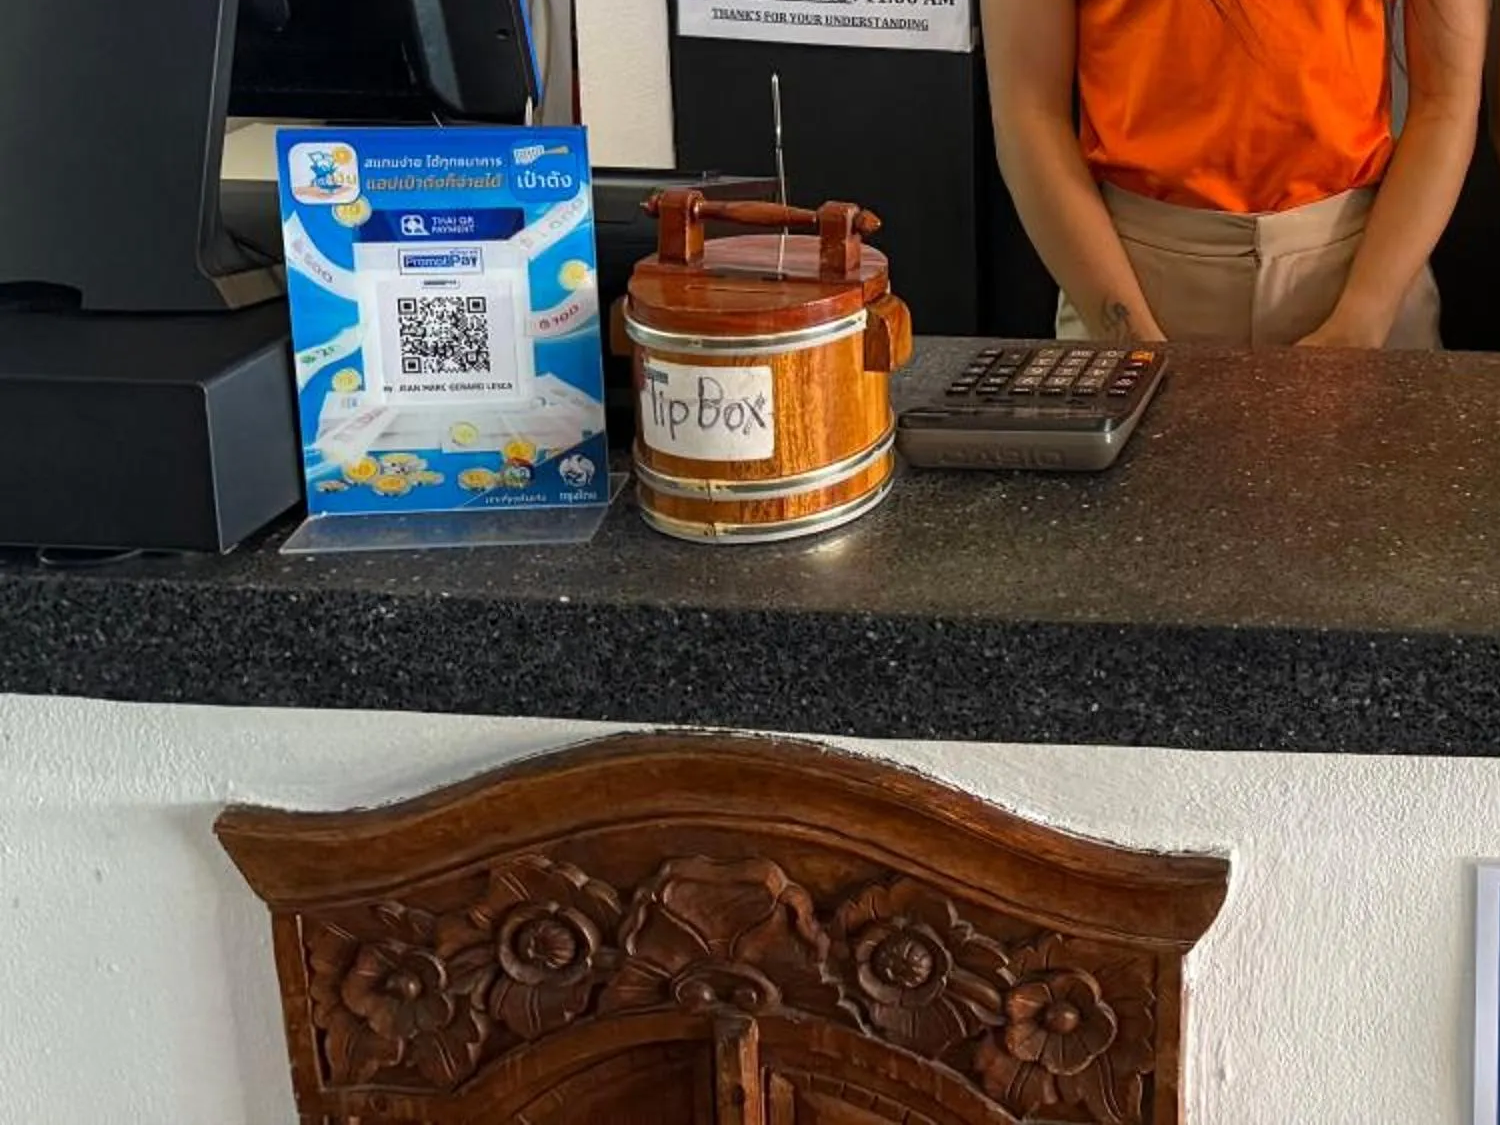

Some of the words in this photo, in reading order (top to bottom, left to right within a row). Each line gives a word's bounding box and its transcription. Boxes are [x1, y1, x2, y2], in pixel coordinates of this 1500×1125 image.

[764, 11, 787, 23] FOR
[790, 14, 822, 25] YOUR
[825, 15, 929, 31] UNDERSTANDING
[431, 216, 456, 224] THAI
[645, 366, 689, 441] Tip
[698, 376, 767, 435] Box
